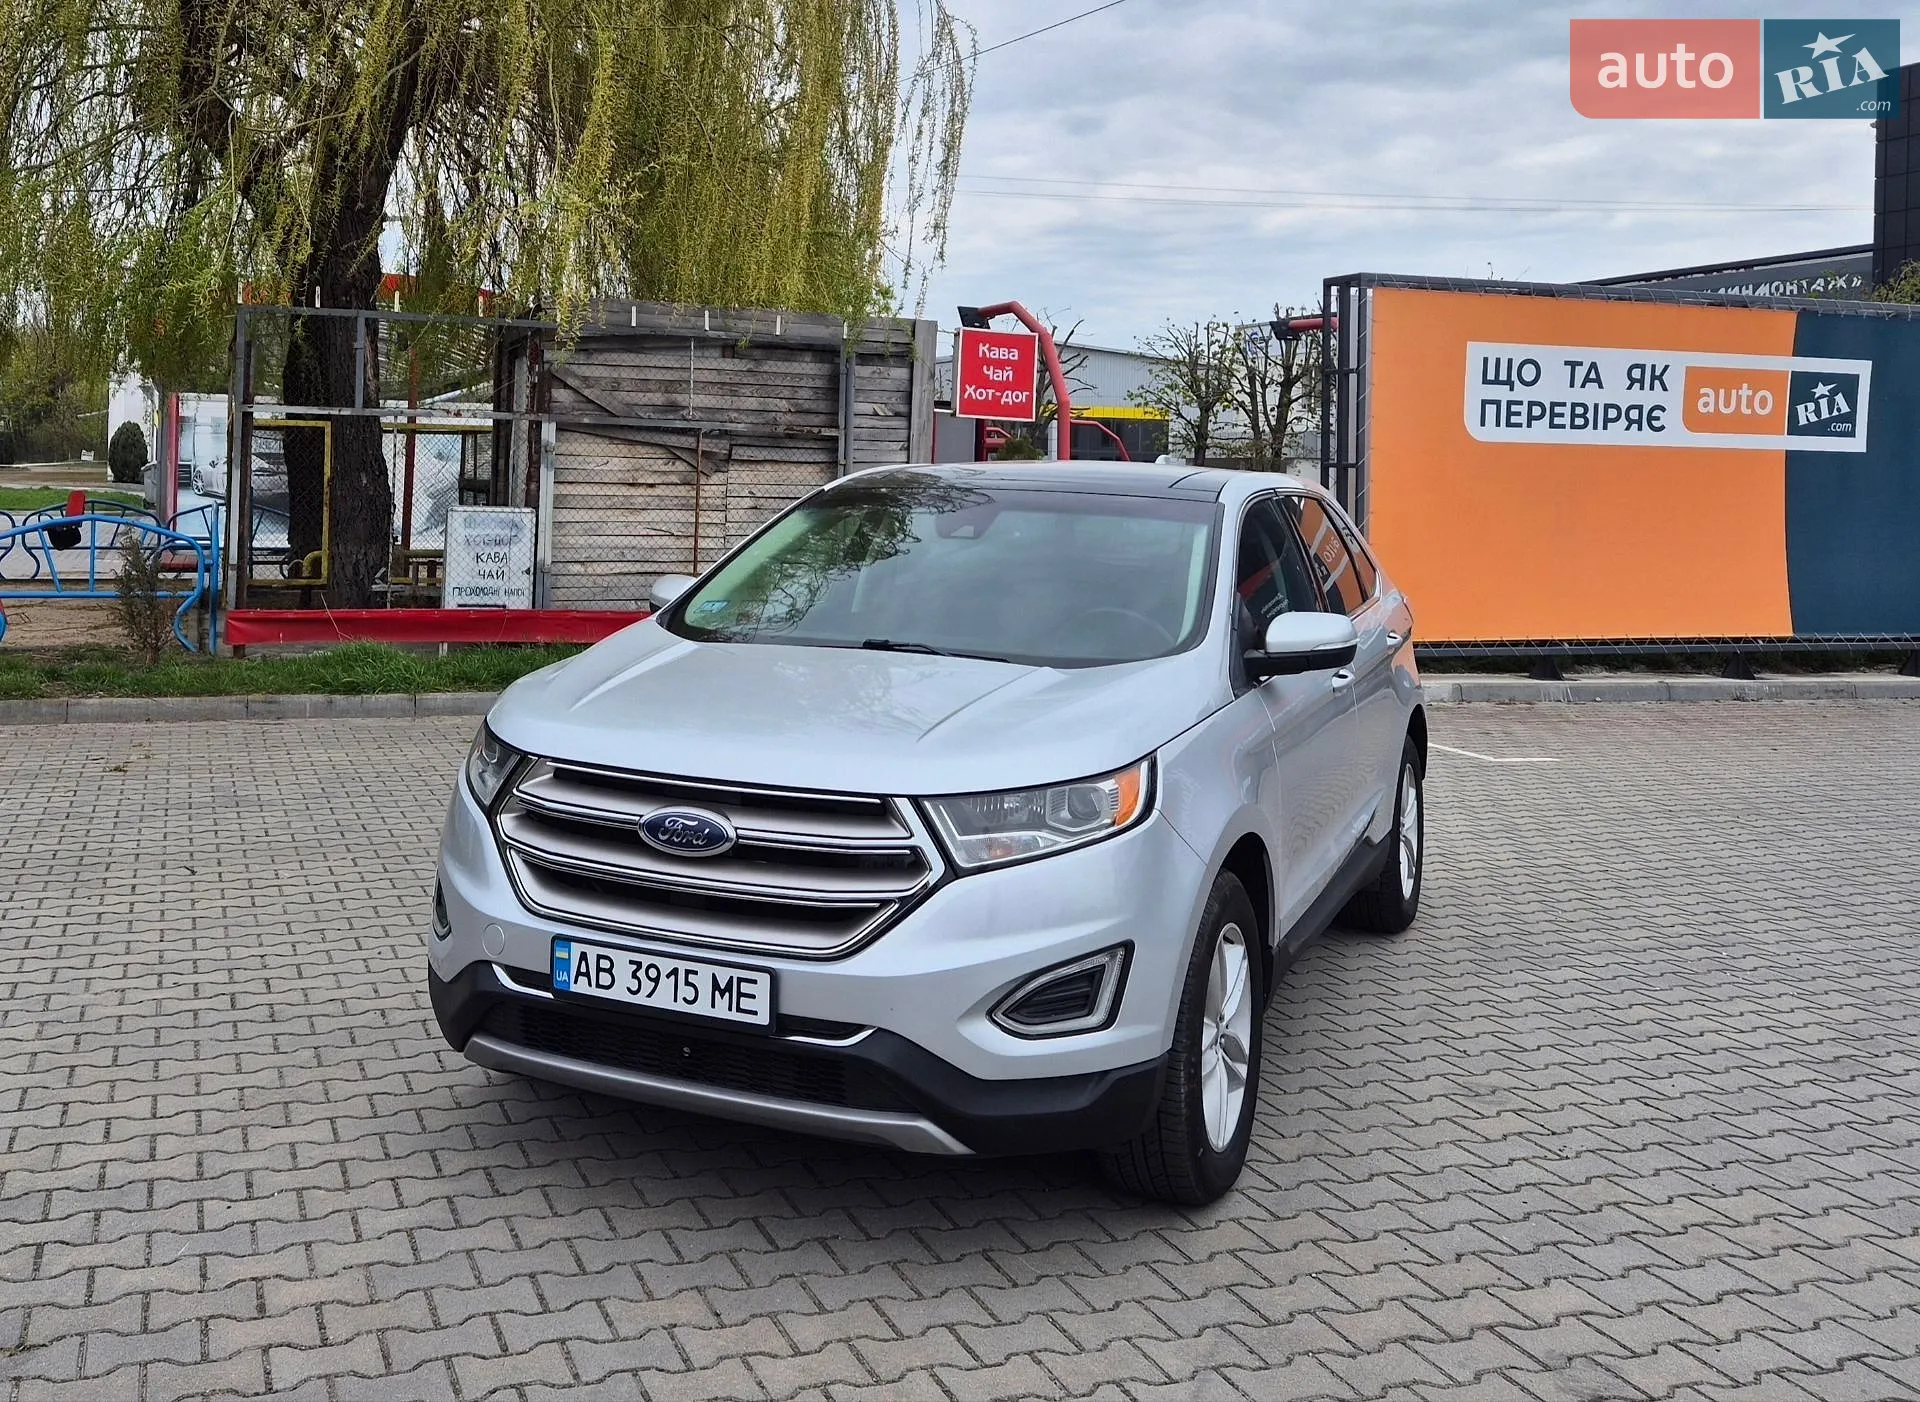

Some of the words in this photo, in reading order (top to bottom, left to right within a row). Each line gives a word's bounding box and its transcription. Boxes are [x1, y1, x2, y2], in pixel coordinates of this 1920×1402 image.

[978, 342, 1019, 360] Кава
[983, 365, 1013, 381] Чай
[1481, 356, 1541, 392] ЩО
[1564, 360, 1604, 390] ТА
[1626, 363, 1670, 392] ЯК
[964, 384, 1029, 405] Хот-дог
[1697, 383, 1773, 415] auto
[1796, 391, 1851, 426] RIA
[1479, 398, 1667, 433] ПЕРЕВІРЯЄ
[1827, 421, 1852, 432] .com
[476, 552, 508, 564] КАВА
[478, 566, 505, 581] ЧАЙ
[657, 817, 709, 845] Ford
[556, 969, 569, 983] UA
[573, 951, 616, 991] AB
[626, 959, 700, 1006] 3915
[711, 972, 759, 1016] ME
